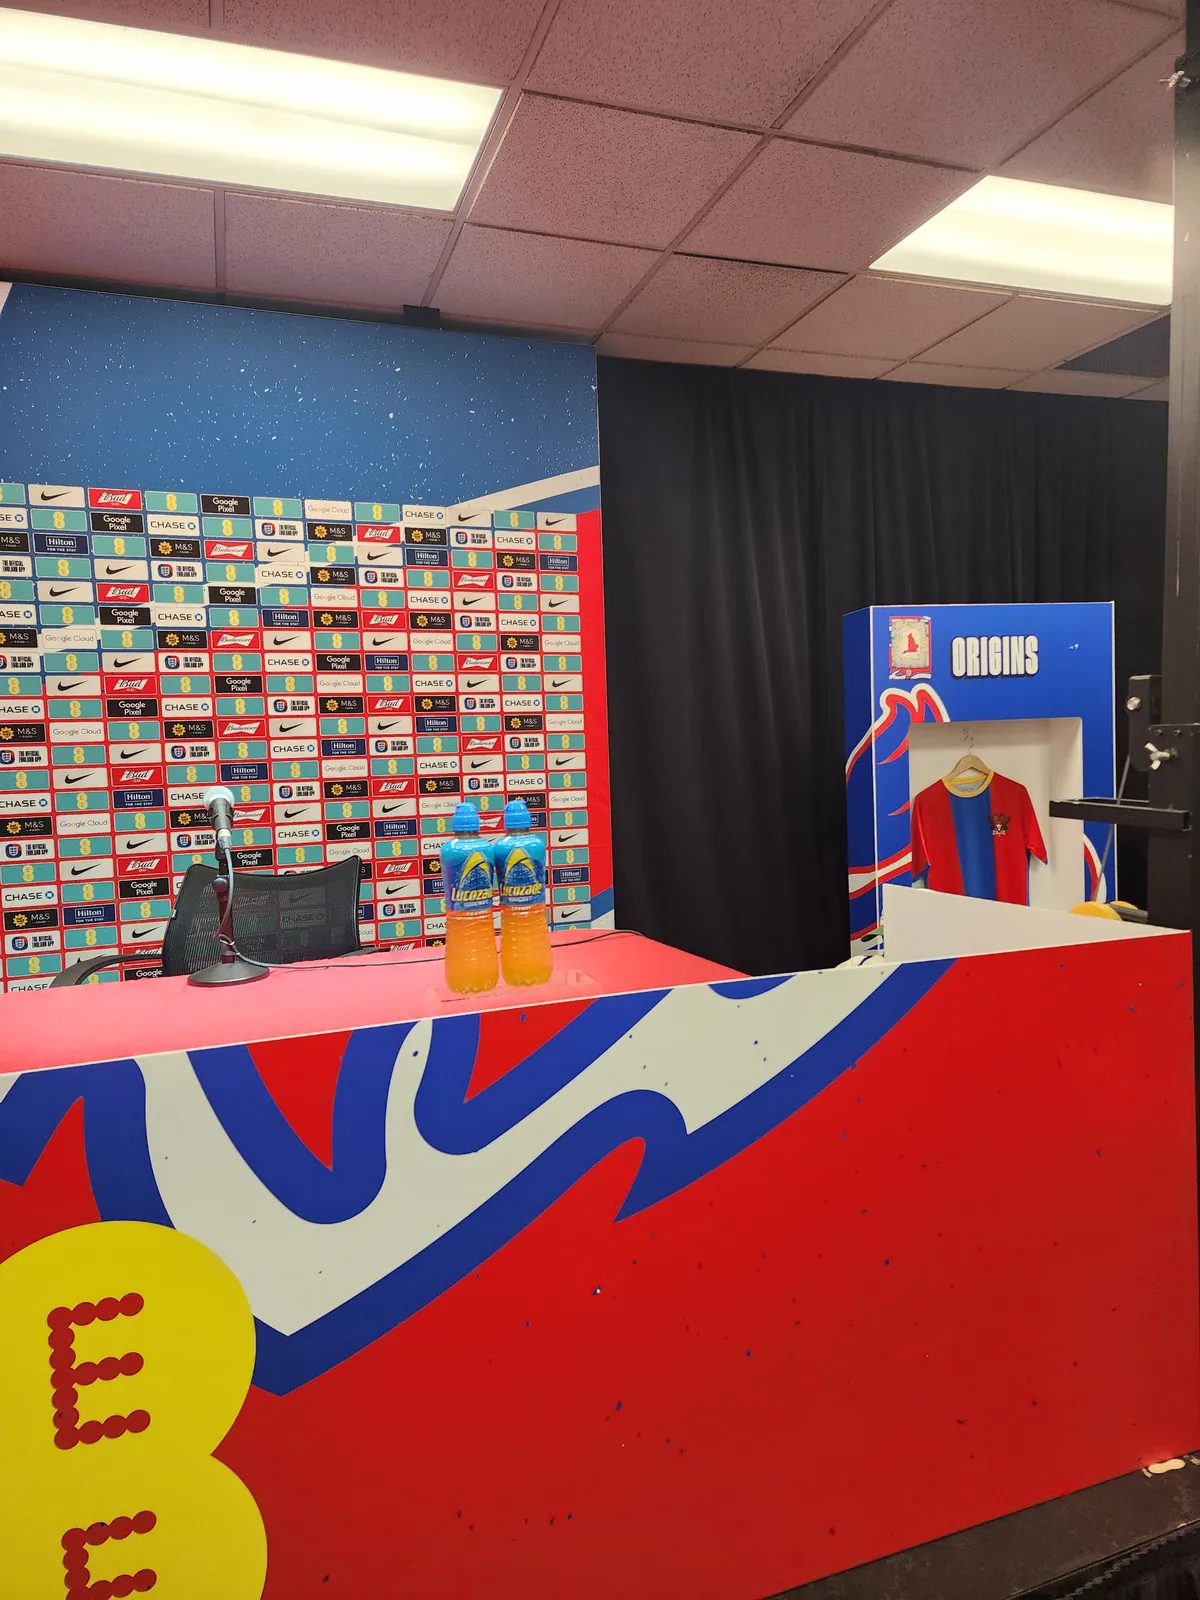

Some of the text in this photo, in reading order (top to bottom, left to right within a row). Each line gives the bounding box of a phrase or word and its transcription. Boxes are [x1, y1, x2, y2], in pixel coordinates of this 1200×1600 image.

[103, 493, 127, 501] Bud
[213, 497, 238, 506] Google
[218, 505, 235, 513] Pixel
[308, 506, 349, 514] Google Cloud
[405, 511, 435, 519] CHASE
[103, 515, 131, 524] Google
[109, 523, 127, 531] Pixel
[151, 521, 185, 529] CHASE
[369, 528, 389, 536] Bud
[111, 587, 136, 596] Bud
[220, 588, 245, 597] Google
[225, 595, 241, 603] Pixel
[111, 609, 138, 617] Google
[117, 616, 135, 624] Pixel
[374, 615, 394, 623] Bud
[45, 635, 72, 643] Google
[952, 635, 1039, 677] ORIGINS
[119, 679, 143, 687] Bud
[226, 677, 251, 685] Google
[320, 680, 341, 688] Google
[231, 684, 247, 692] Pixel
[118, 701, 145, 709] Google
[124, 708, 142, 716] Pixel
[53, 728, 79, 736] Google
[125, 769, 149, 779] Bud
[384, 782, 404, 790] Bud
[127, 793, 150, 801] Hilton
[0, 800, 36, 808] CHASE
[329, 848, 351, 856] Google
[131, 860, 154, 868] Bud
[242, 858, 258, 866] Pixel
[131, 882, 158, 890] Google
[500, 882, 542, 897] Lucozade
[5, 892, 43, 902] CHASE
[136, 970, 163, 978] Google
[47, 1292, 151, 1450] E
